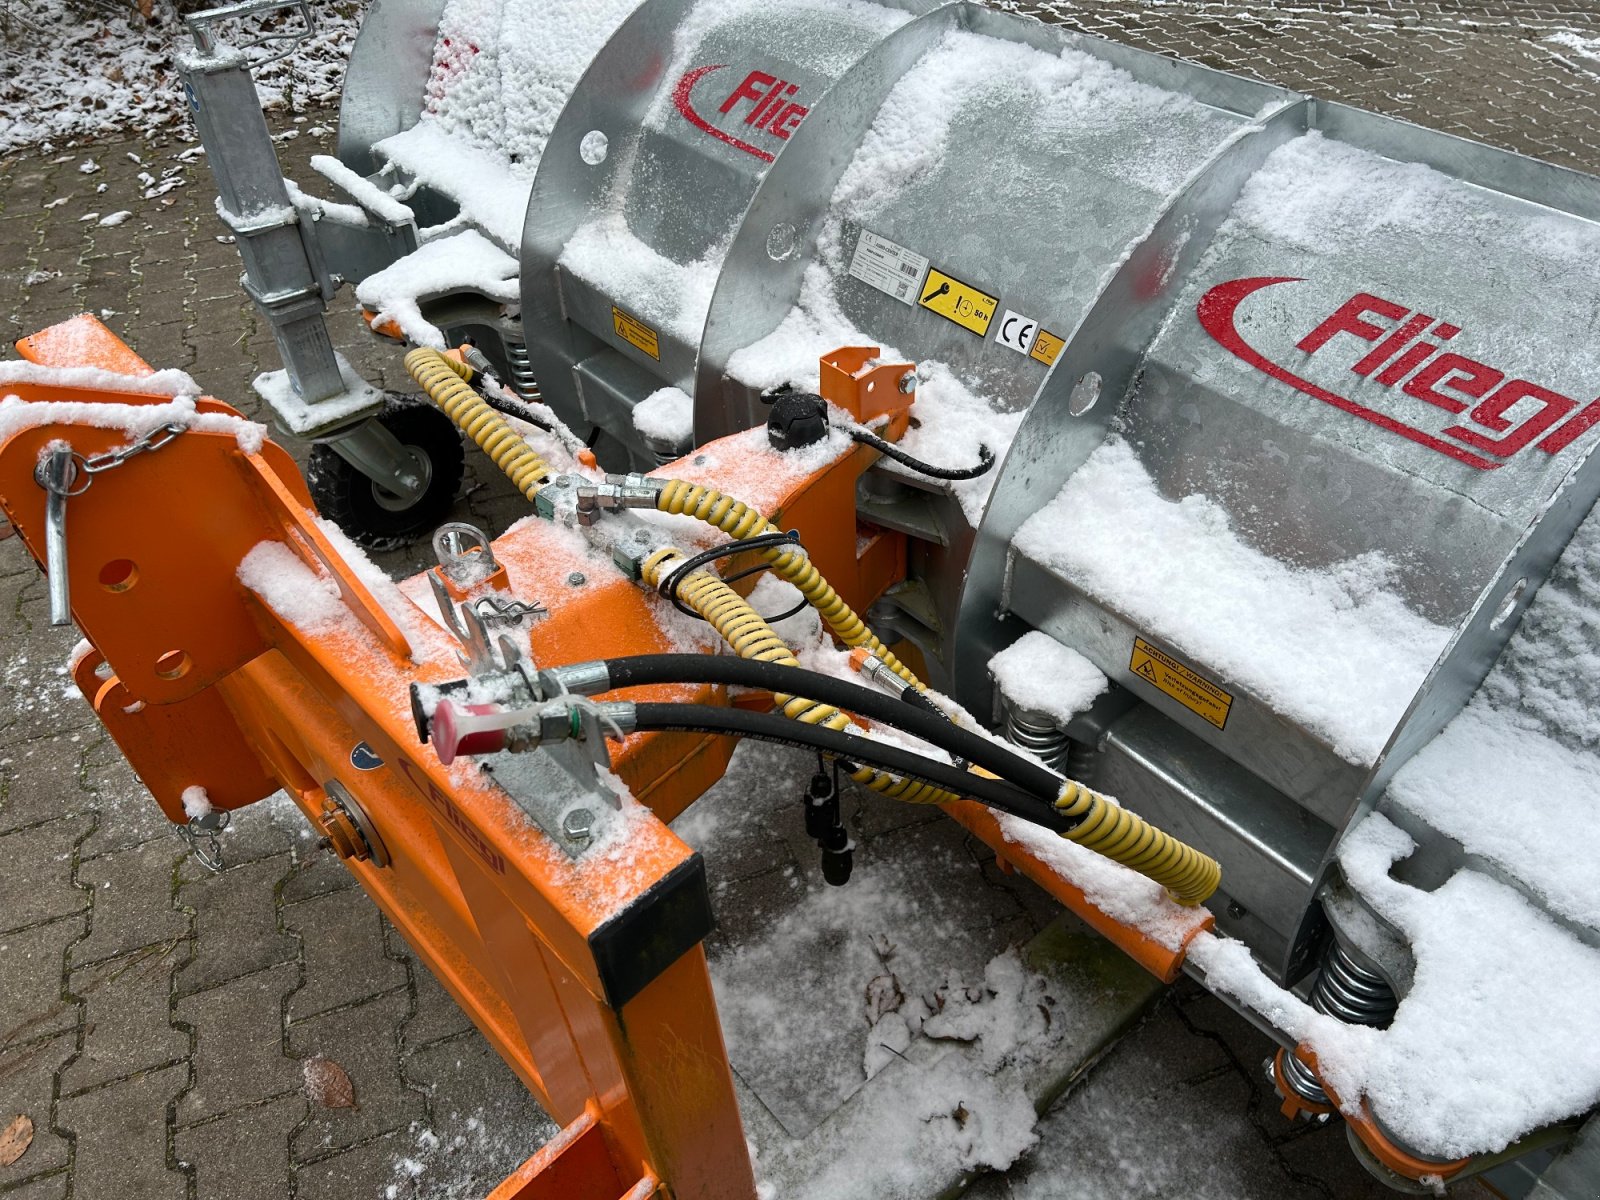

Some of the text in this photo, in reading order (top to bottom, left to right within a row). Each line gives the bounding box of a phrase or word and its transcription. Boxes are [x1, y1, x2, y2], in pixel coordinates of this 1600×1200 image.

[719, 70, 810, 141] Flie
[974, 309, 983, 319] 50
[1003, 318, 1033, 349] CE
[1296, 293, 1600, 457] Fliegl
[1143, 645, 1180, 670] ACHTUNG!
[1186, 671, 1222, 698] WARNING!
[428, 782, 506, 876] Fliegl
